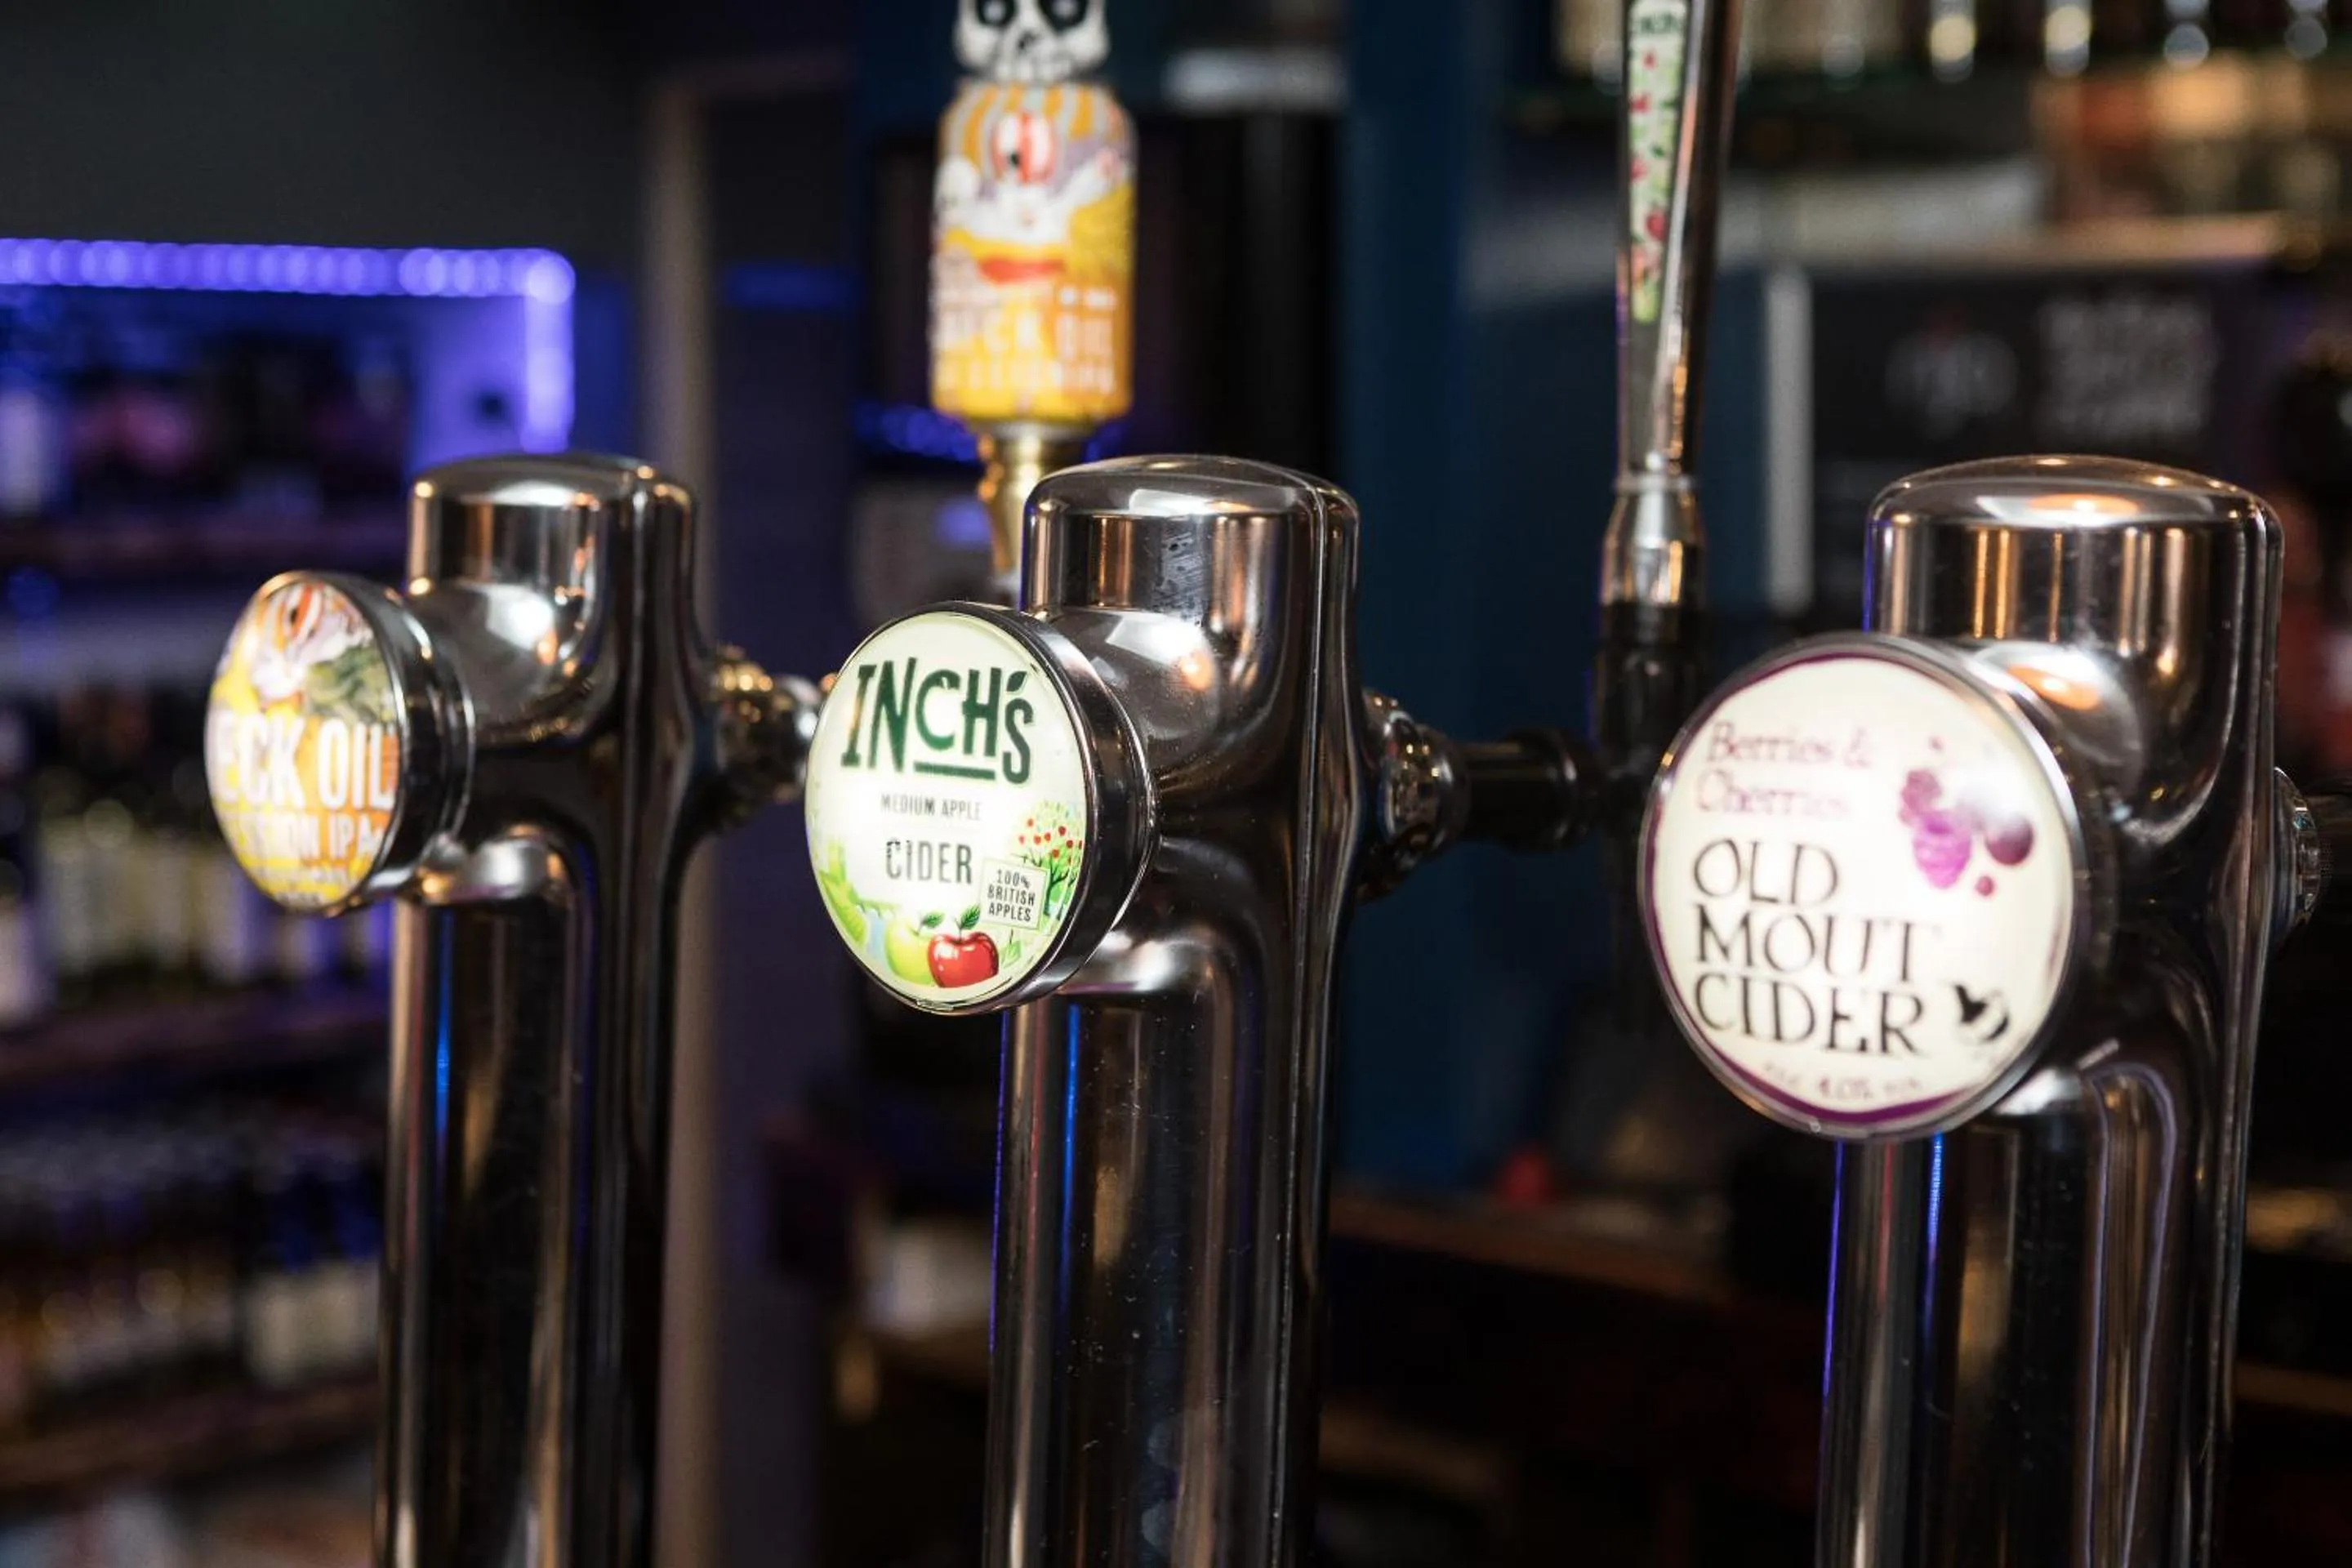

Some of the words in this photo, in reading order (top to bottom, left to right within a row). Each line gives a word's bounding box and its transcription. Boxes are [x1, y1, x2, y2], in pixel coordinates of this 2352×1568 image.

[211, 708, 305, 808] ECK
[317, 719, 395, 809] OIL
[1707, 722, 1835, 763] Berries
[880, 793, 937, 816] MEDIUM
[942, 798, 982, 821] APPLE
[885, 838, 973, 884] CIDER
[996, 869, 1031, 889] 100%
[1693, 838, 1839, 905] OLD
[987, 883, 1036, 906] BRITISH
[988, 902, 1031, 922] APPLES
[1695, 902, 1944, 982] MOUT
[1694, 972, 1927, 1055] CIDER
